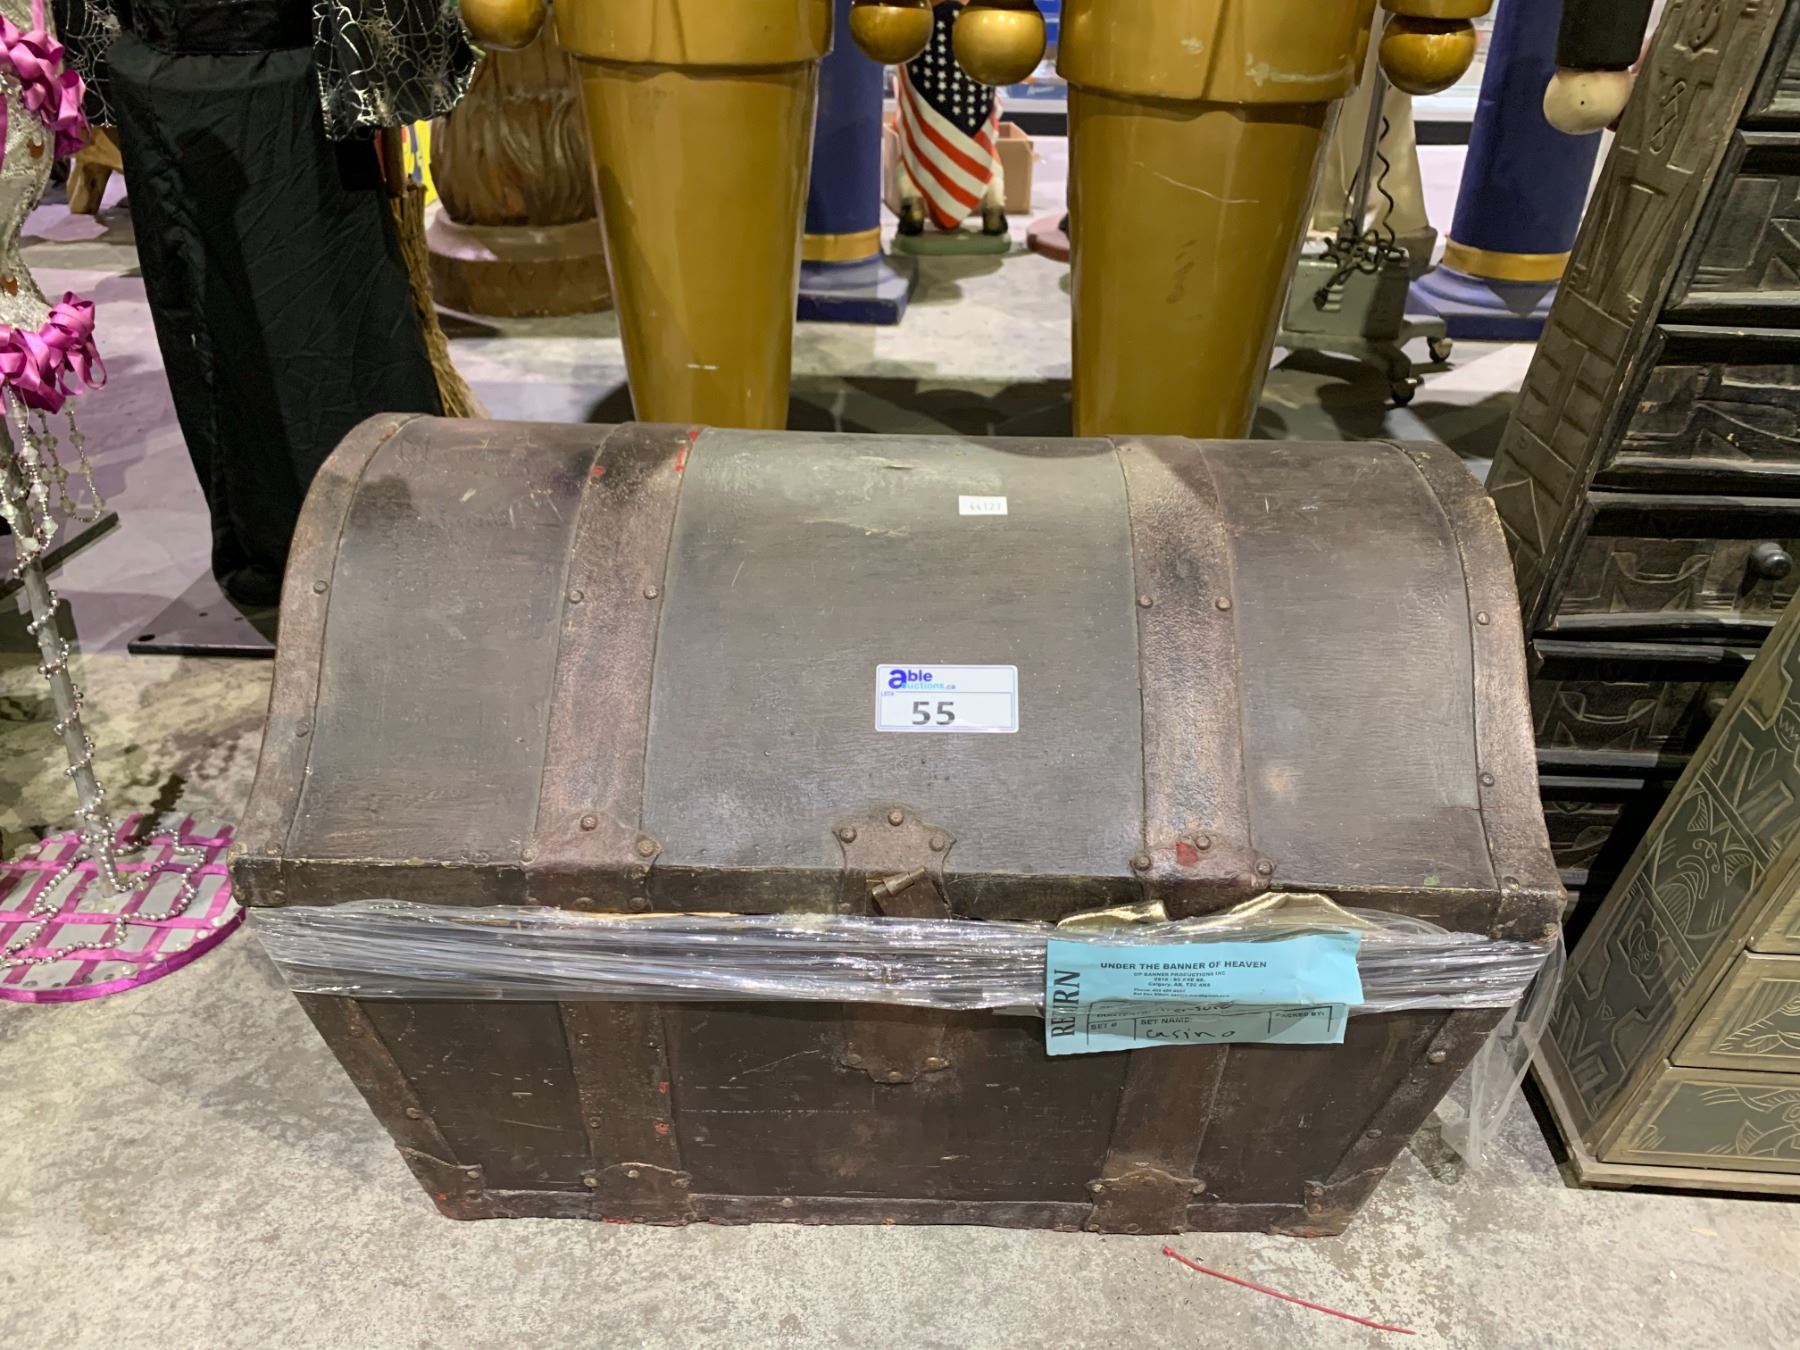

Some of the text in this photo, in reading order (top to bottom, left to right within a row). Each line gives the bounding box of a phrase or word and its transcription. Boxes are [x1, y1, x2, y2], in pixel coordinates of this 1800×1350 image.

[911, 701, 956, 725] 55
[1100, 962, 1136, 970] UNDER
[1163, 962, 1206, 970] BANNER
[1208, 961, 1222, 969] OF
[1224, 960, 1267, 968] HEAVEN
